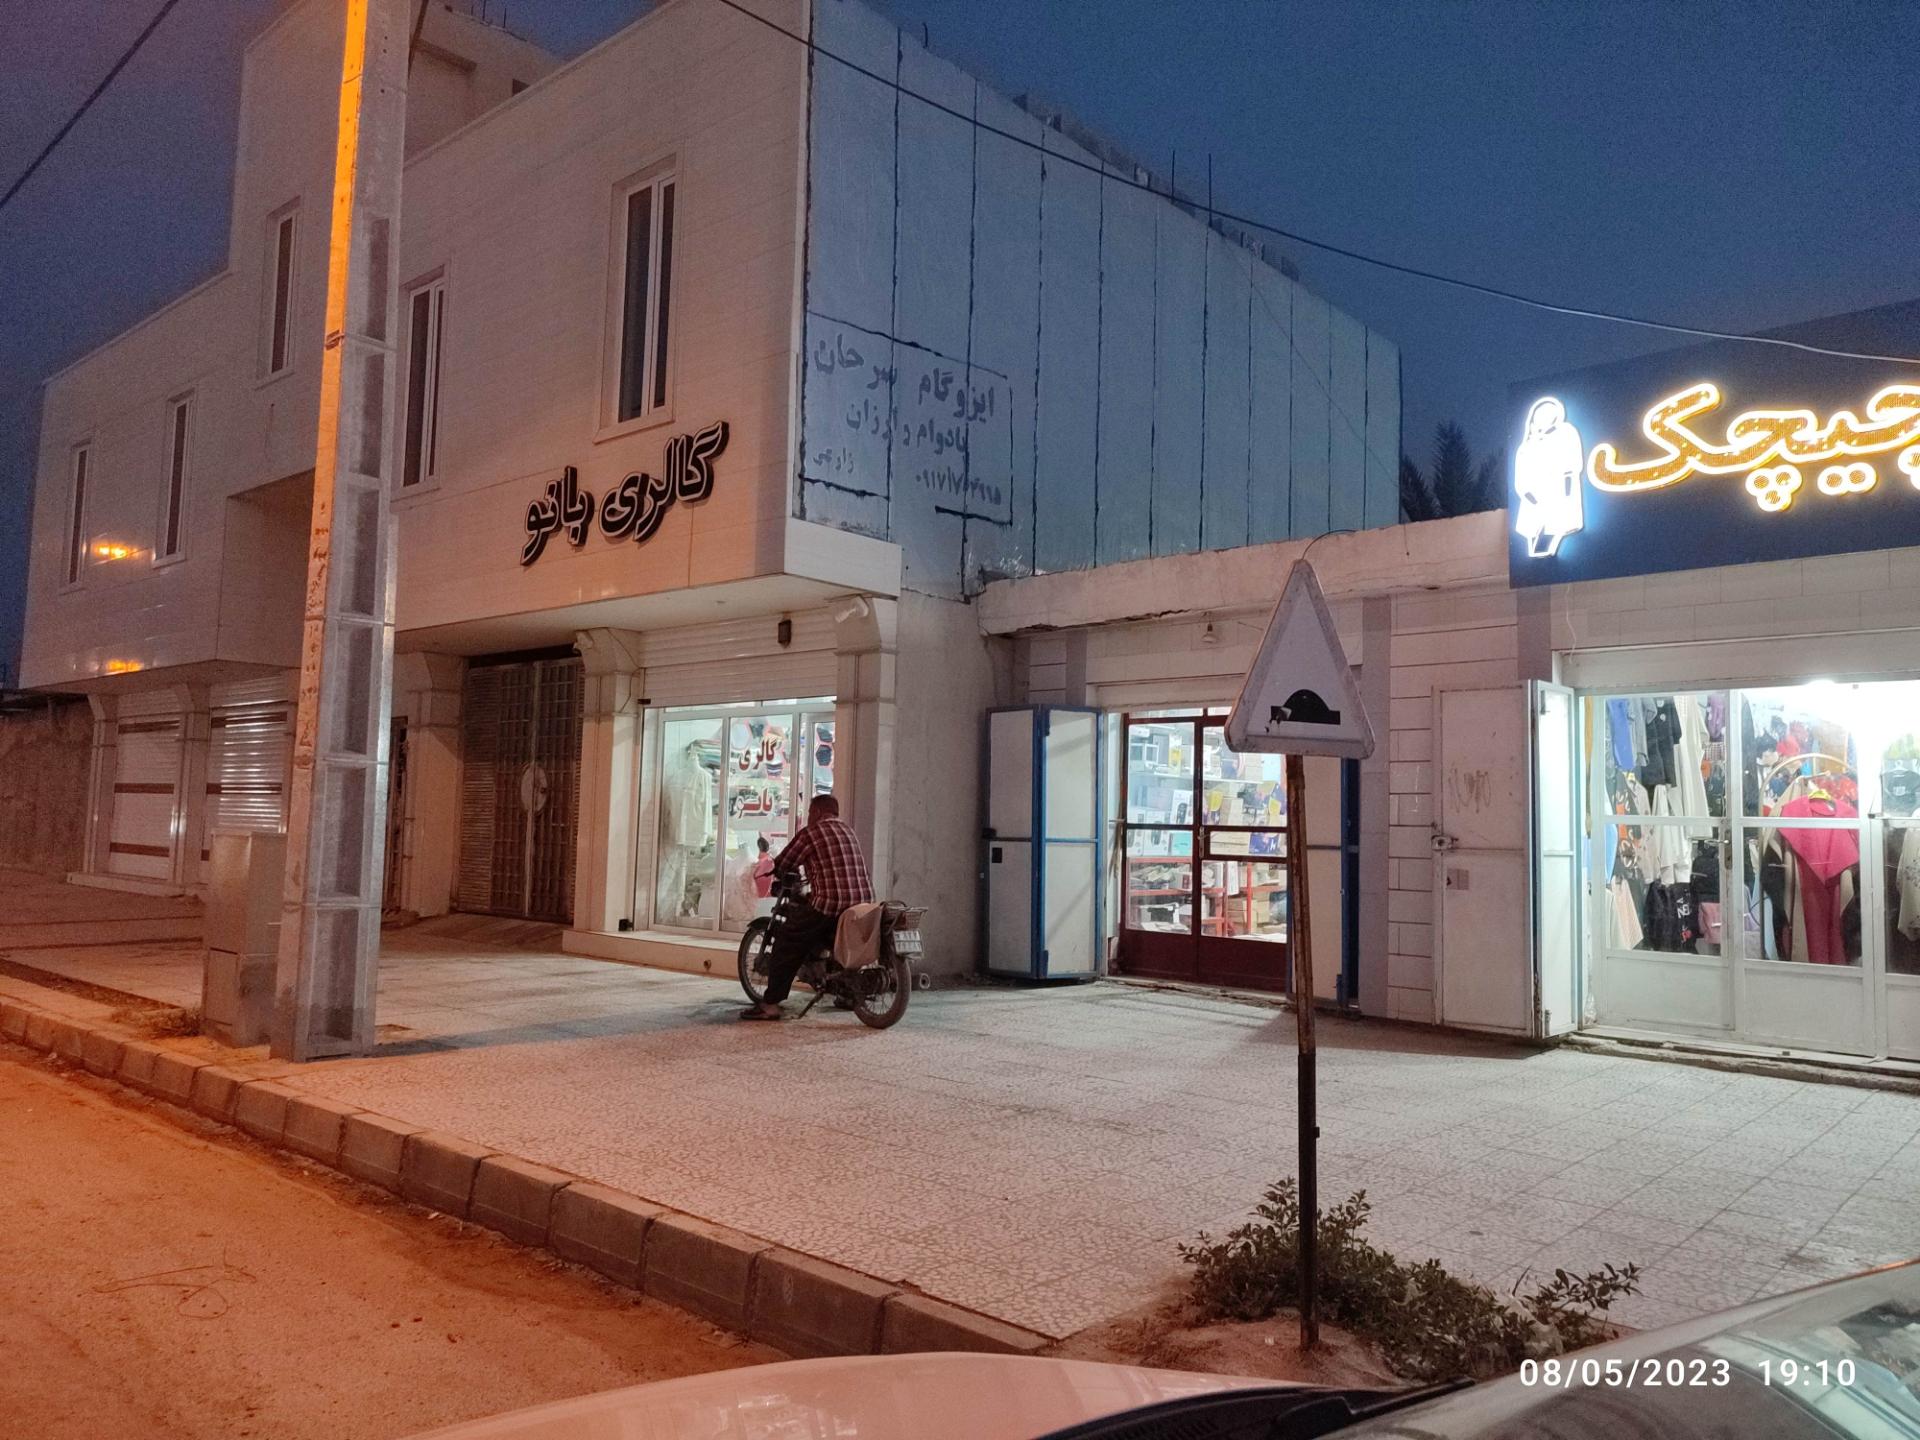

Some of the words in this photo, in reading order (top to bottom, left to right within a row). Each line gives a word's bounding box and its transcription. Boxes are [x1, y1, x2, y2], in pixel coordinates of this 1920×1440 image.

[598, 420, 729, 541] گالری
[520, 465, 595, 566] بانو
[738, 738, 777, 771] گالری
[736, 787, 774, 819] بانو
